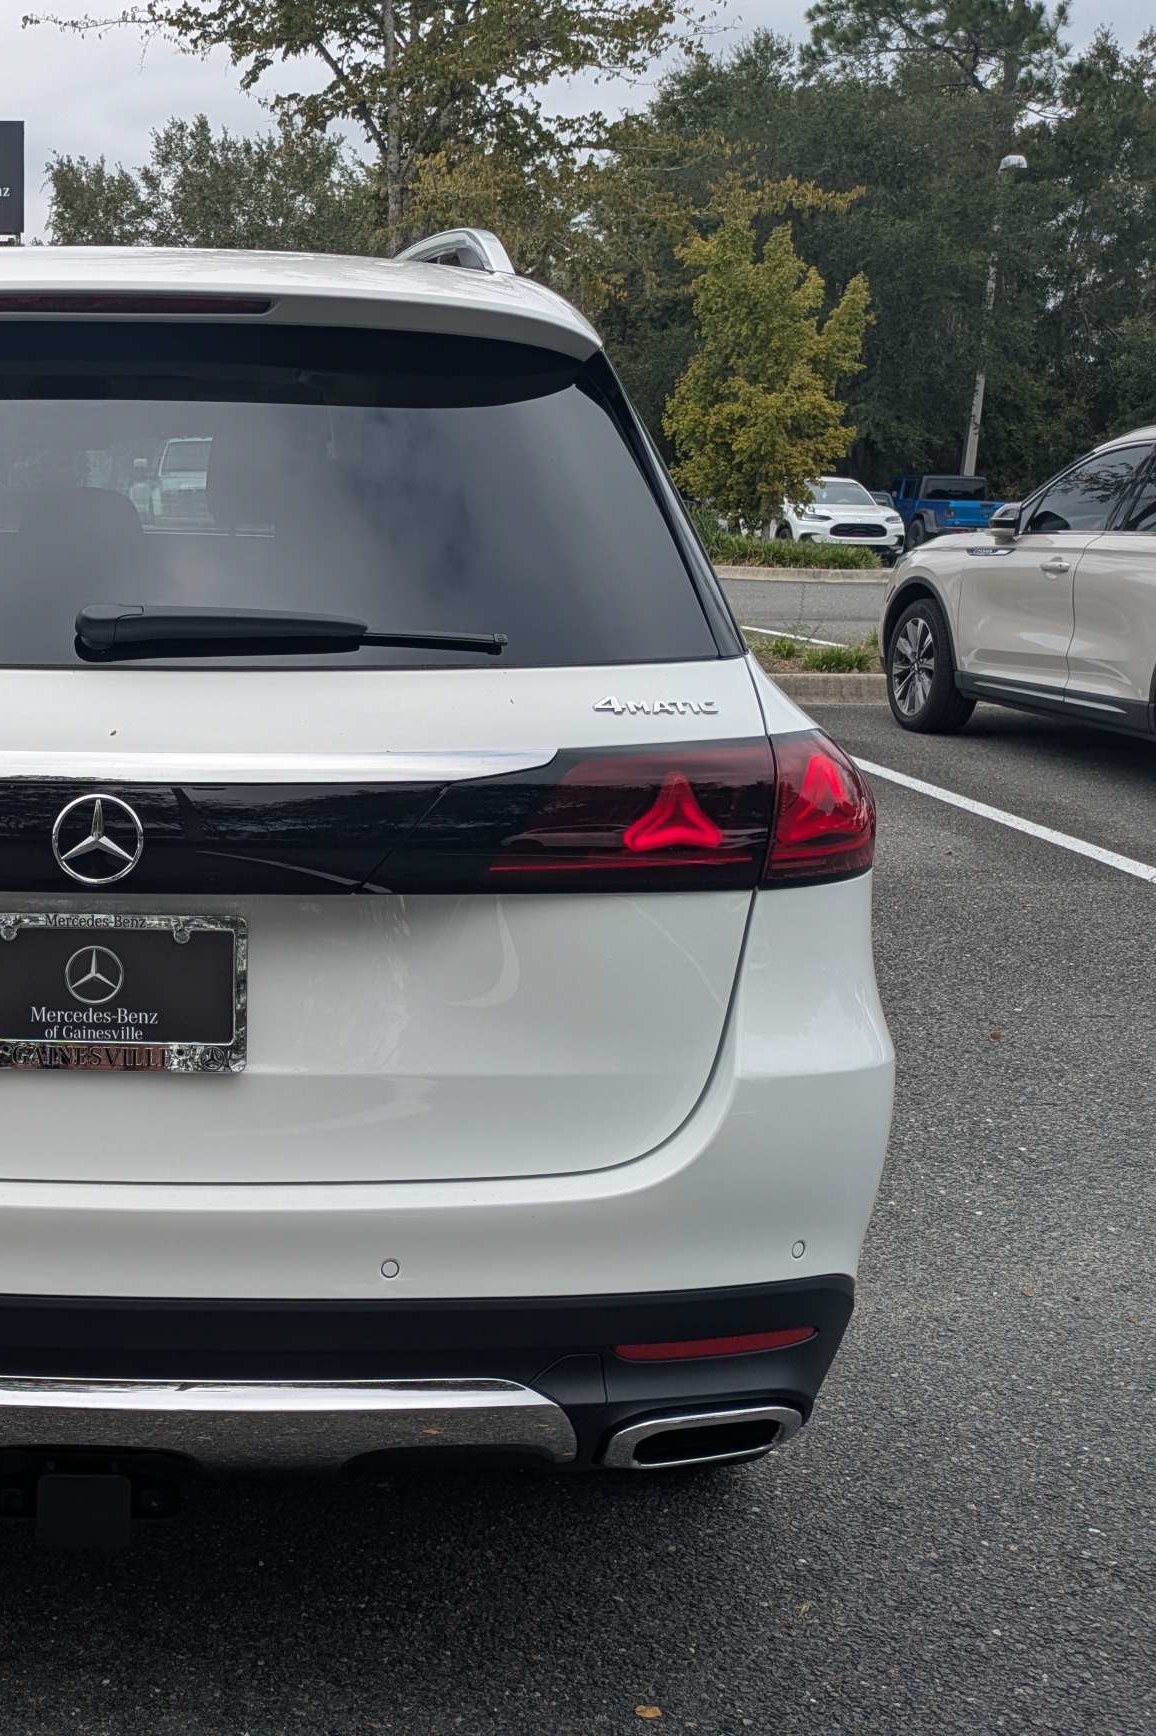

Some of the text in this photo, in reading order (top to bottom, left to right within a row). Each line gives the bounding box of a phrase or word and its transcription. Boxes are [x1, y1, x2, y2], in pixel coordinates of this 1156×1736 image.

[593, 696, 719, 715] 4MATIC
[45, 913, 147, 928] Mercedes-Benz
[30, 1006, 159, 1025] Mercedes-Benz
[44, 1025, 144, 1041] of Gainesville
